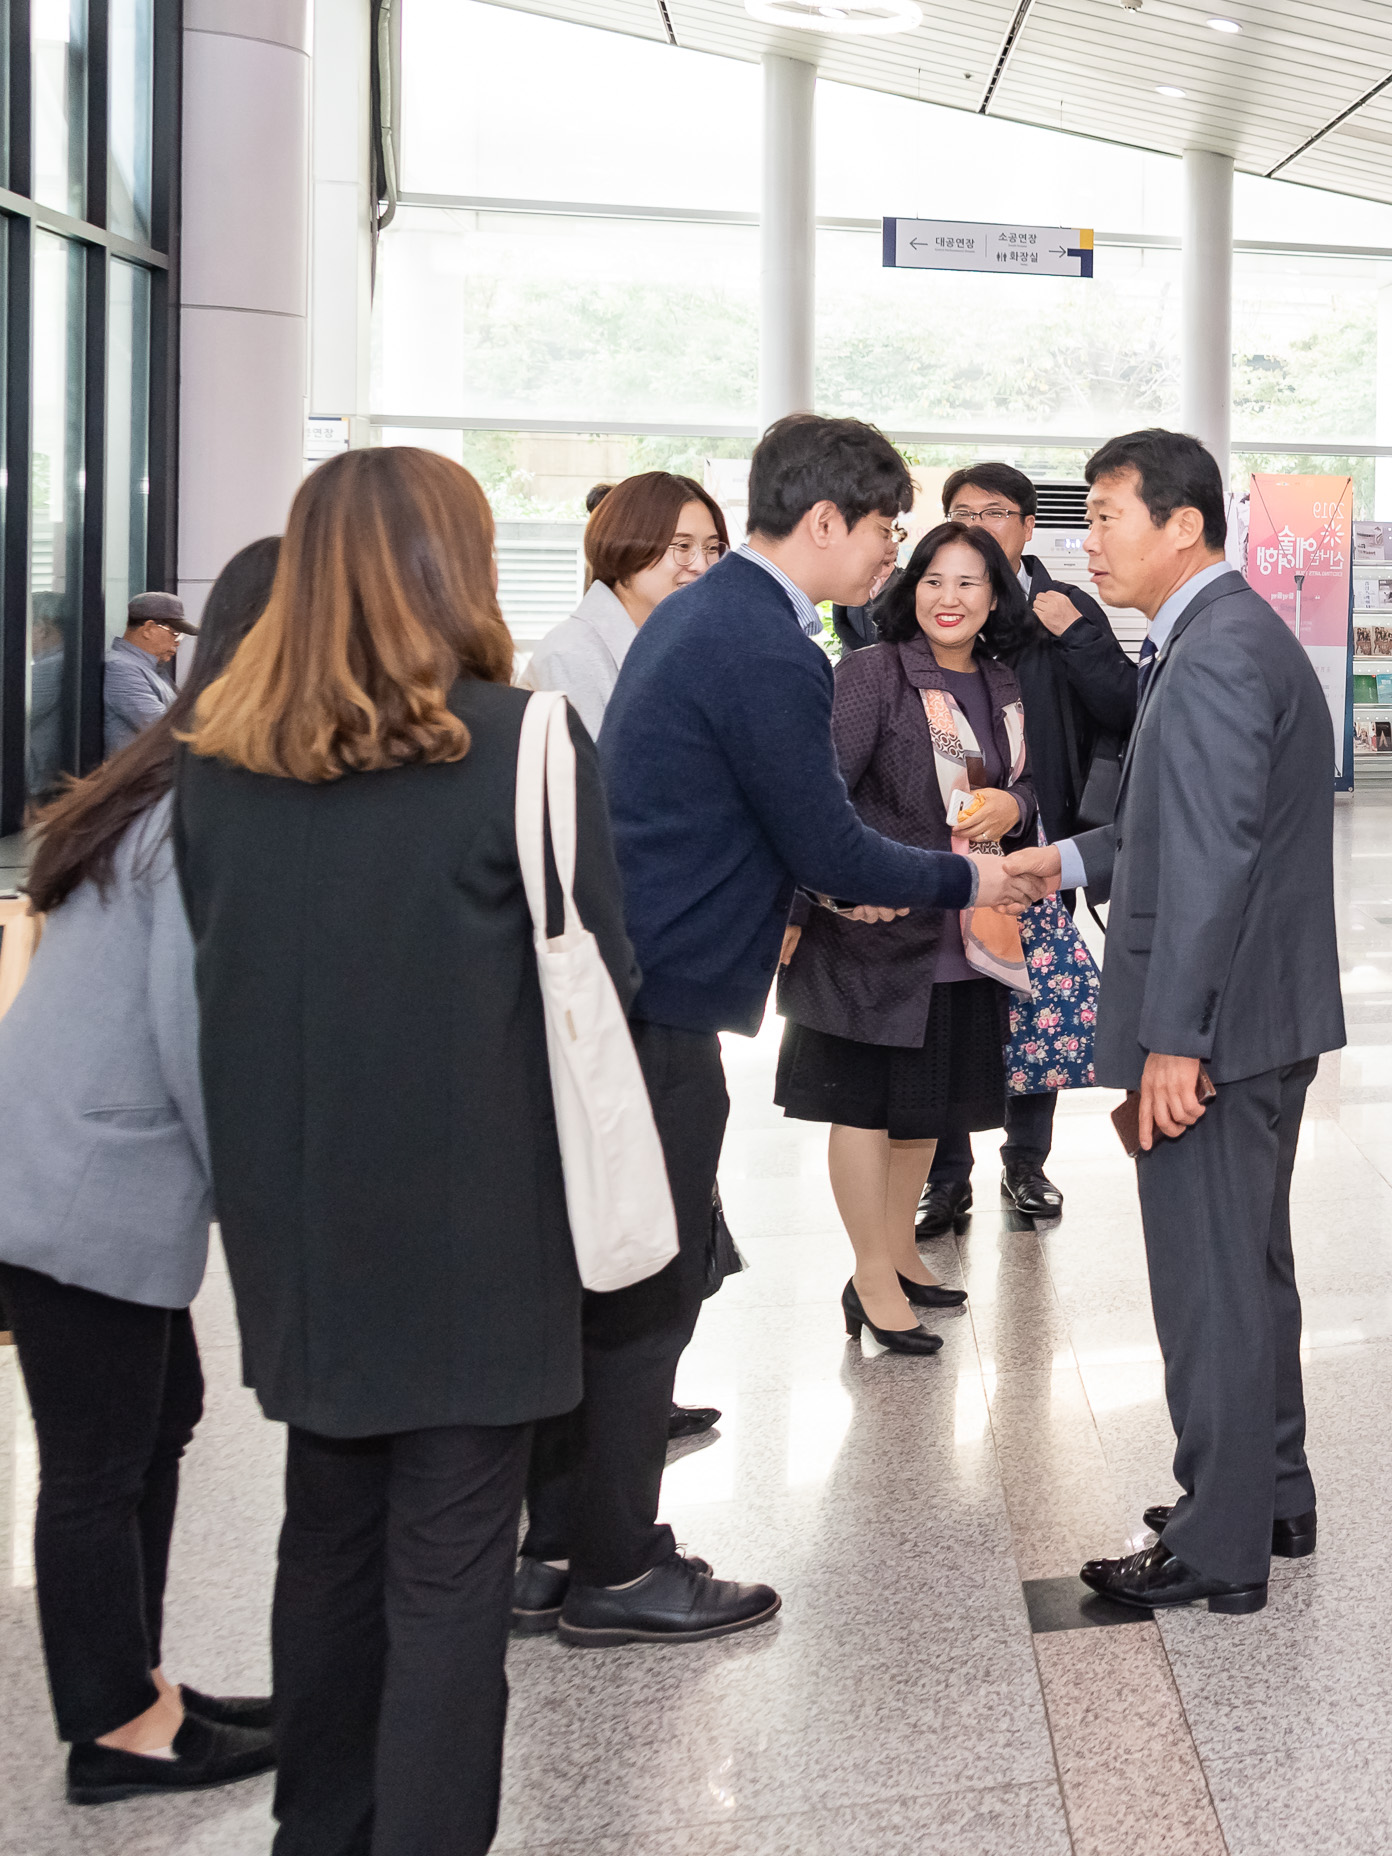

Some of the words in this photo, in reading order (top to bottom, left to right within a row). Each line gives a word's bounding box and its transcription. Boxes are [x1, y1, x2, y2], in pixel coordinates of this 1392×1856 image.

[935, 236, 975, 249] 대공연장
[998, 232, 1037, 245] 소공연장
[1009, 251, 1038, 263] 화장실
